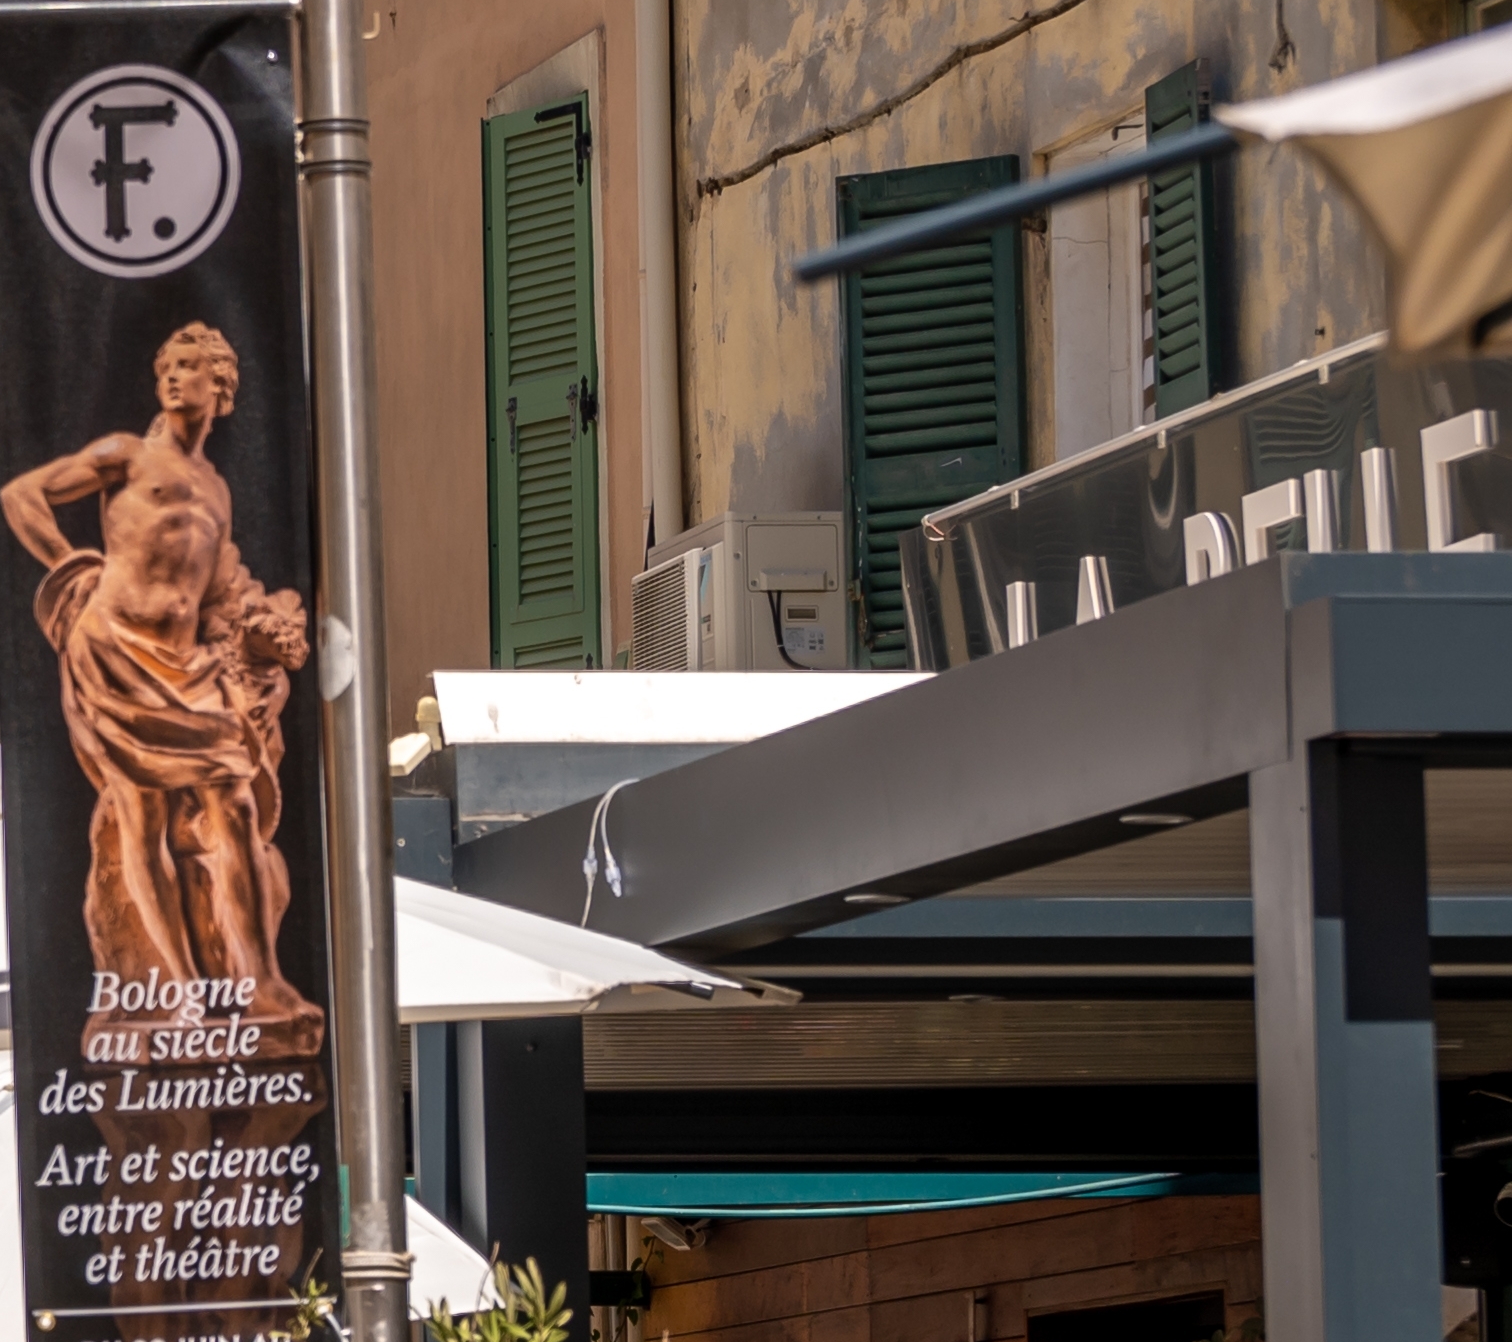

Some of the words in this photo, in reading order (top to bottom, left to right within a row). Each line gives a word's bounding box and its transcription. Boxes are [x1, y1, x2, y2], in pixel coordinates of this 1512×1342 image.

[87, 967, 257, 1026] Bologne
[86, 1032, 140, 1063] au
[150, 1015, 261, 1060] siècle
[39, 1068, 107, 1115] des
[116, 1065, 313, 1112] Lumières.
[35, 1143, 112, 1187] Art
[120, 1149, 161, 1185] et
[168, 1139, 321, 1185] science,
[57, 1198, 163, 1237] entre
[173, 1181, 304, 1231] réalité
[84, 1248, 126, 1285] et
[135, 1236, 281, 1282] théâtre
